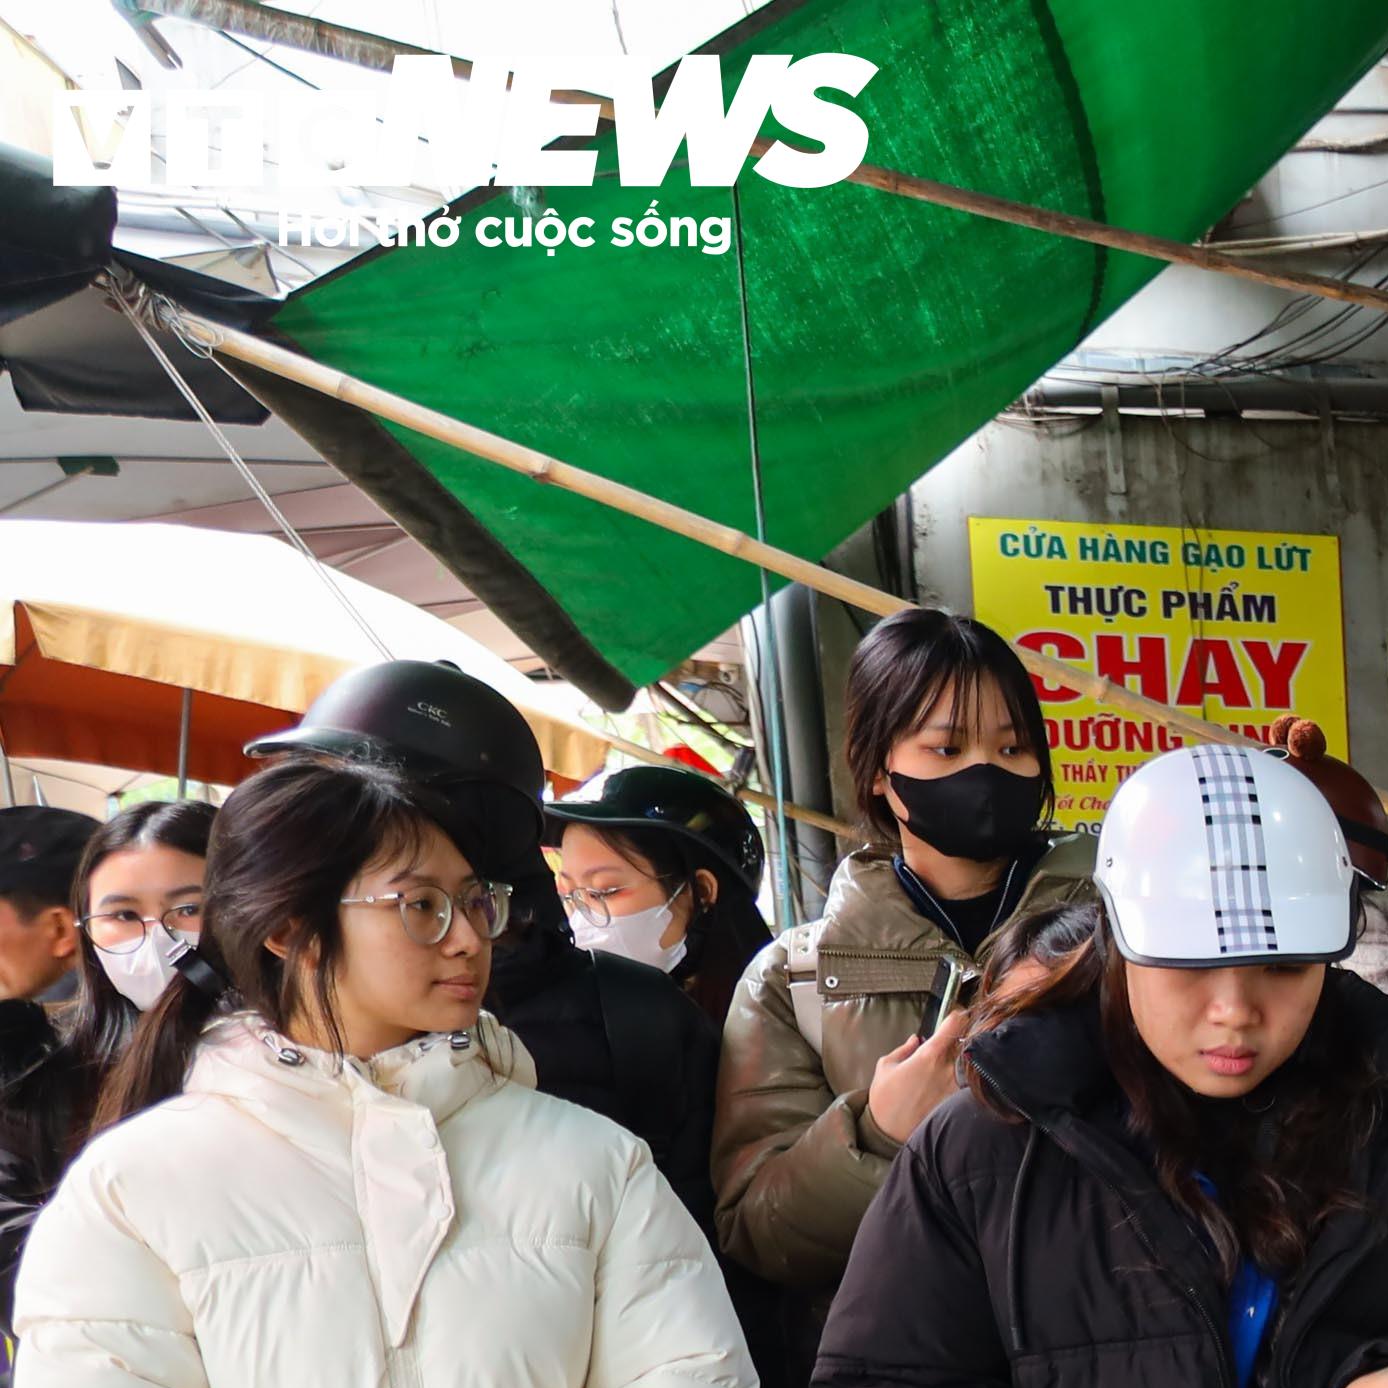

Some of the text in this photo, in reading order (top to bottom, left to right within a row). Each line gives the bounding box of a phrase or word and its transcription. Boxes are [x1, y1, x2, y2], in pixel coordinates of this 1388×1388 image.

[1000, 525, 1312, 573] CỬA HÀNG GẠO LỨT
[1044, 581, 1277, 623] THỰC PHẨM
[1014, 631, 1308, 710] CHAY
